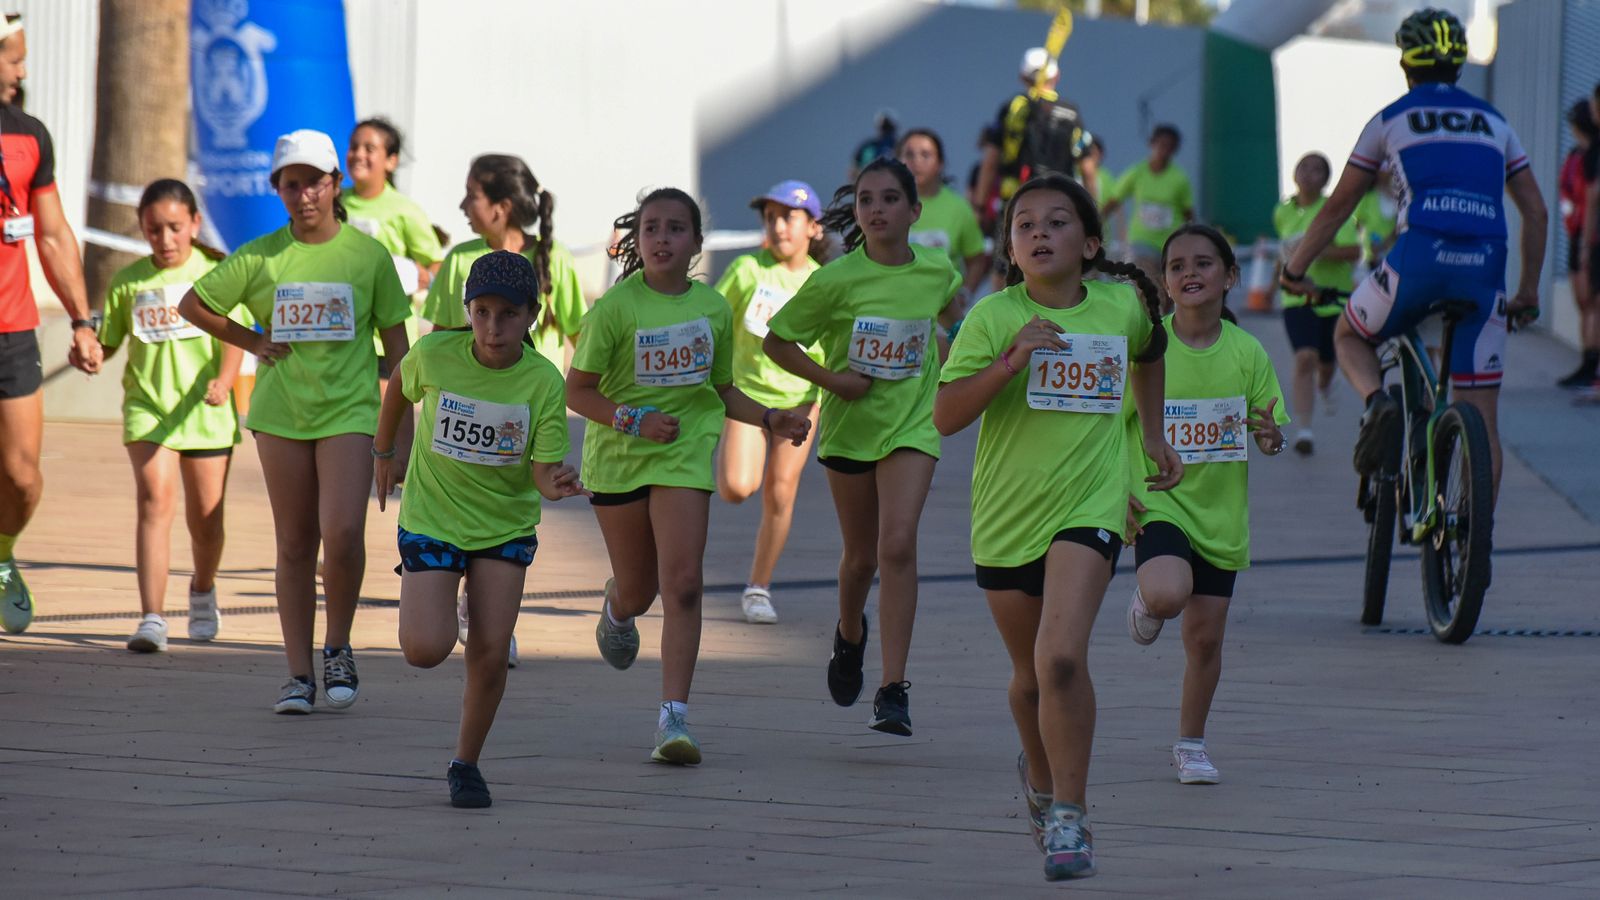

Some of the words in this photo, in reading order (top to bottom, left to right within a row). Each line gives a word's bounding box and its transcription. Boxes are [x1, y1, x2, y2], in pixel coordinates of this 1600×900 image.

[1407, 111, 1494, 138] UCA
[1422, 196, 1497, 220] ALGECIRAS
[136, 305, 179, 328] 1328
[277, 303, 326, 326] 1327
[857, 321, 873, 331] XXI
[639, 335, 655, 345] XXI
[856, 337, 904, 362] 1344
[641, 345, 691, 371] 1349
[1037, 360, 1097, 391] 1395
[442, 397, 458, 411] XXI
[1165, 405, 1181, 416] XXI
[440, 416, 496, 448] 1559
[1167, 422, 1219, 447] 1389
